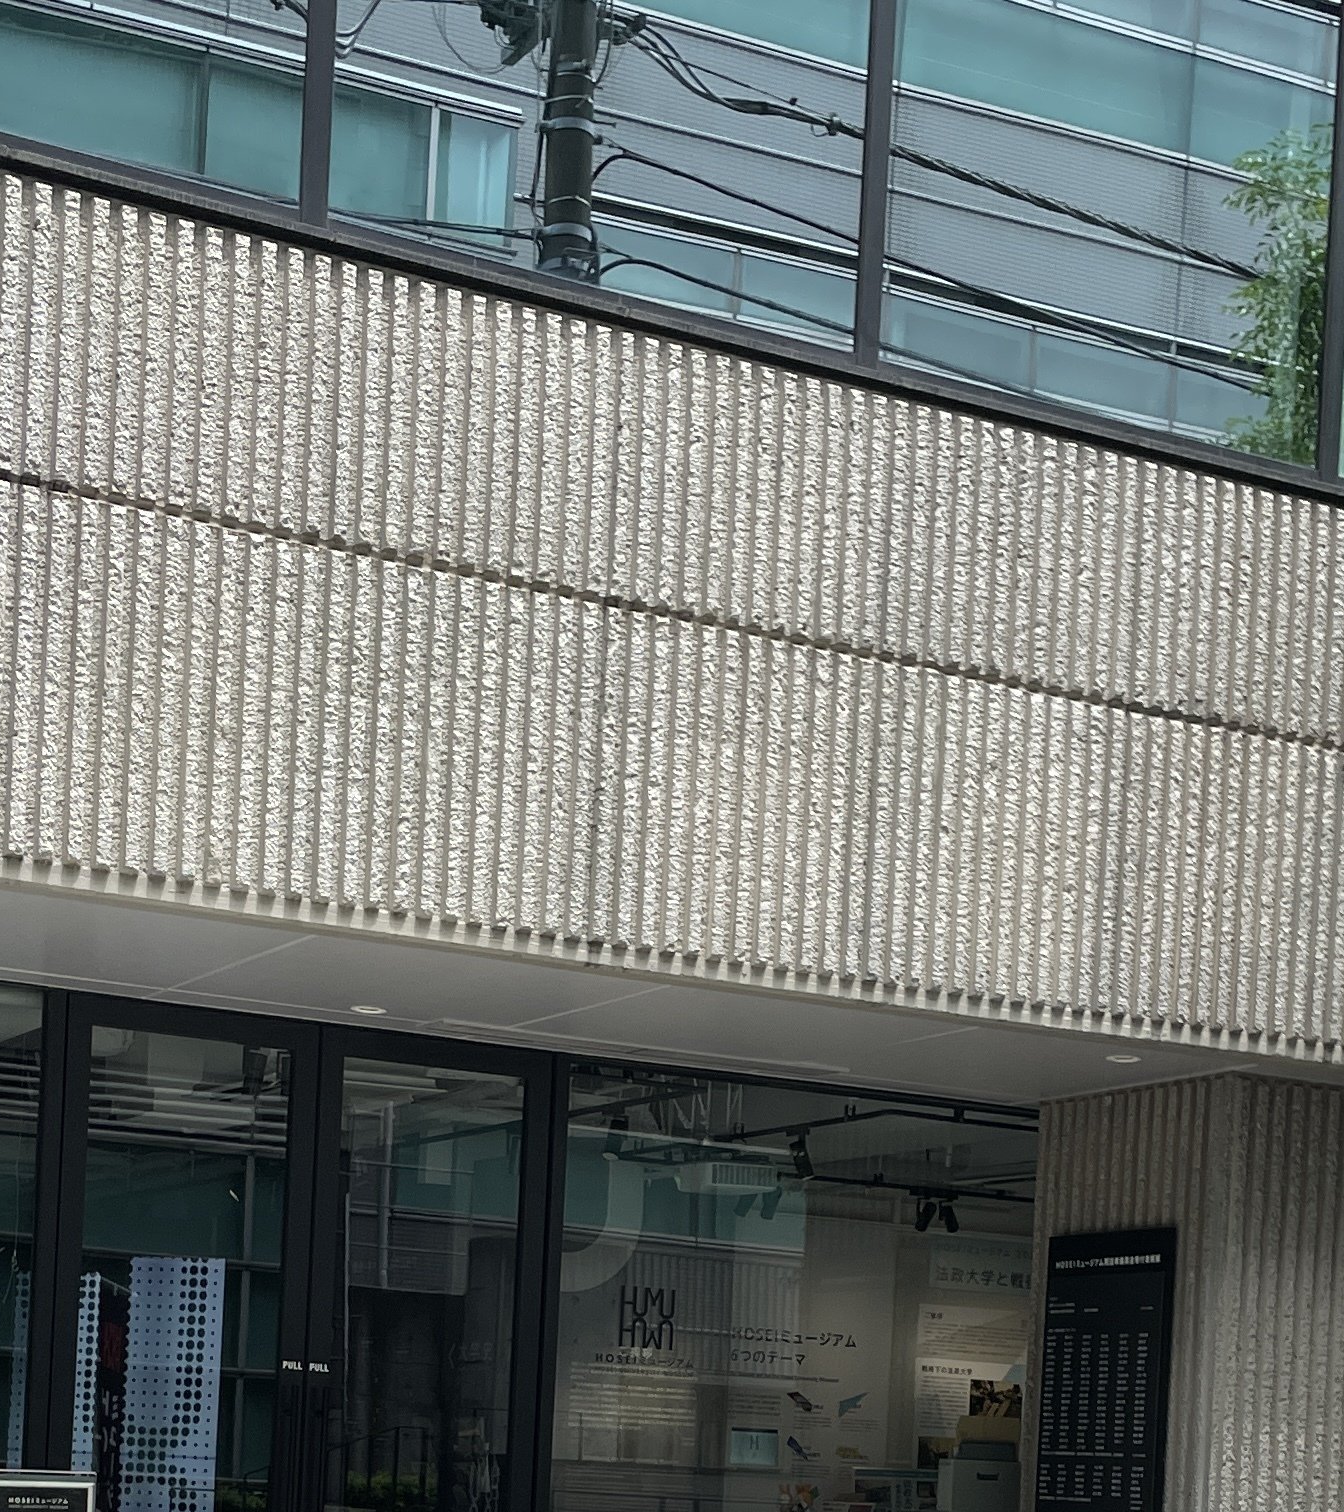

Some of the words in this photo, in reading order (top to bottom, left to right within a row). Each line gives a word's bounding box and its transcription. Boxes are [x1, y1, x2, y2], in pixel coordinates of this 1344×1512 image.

[732, 1327, 856, 1348] HOSEIミュージアム
[282, 1360, 303, 1371] PULL
[309, 1362, 330, 1373] PULL
